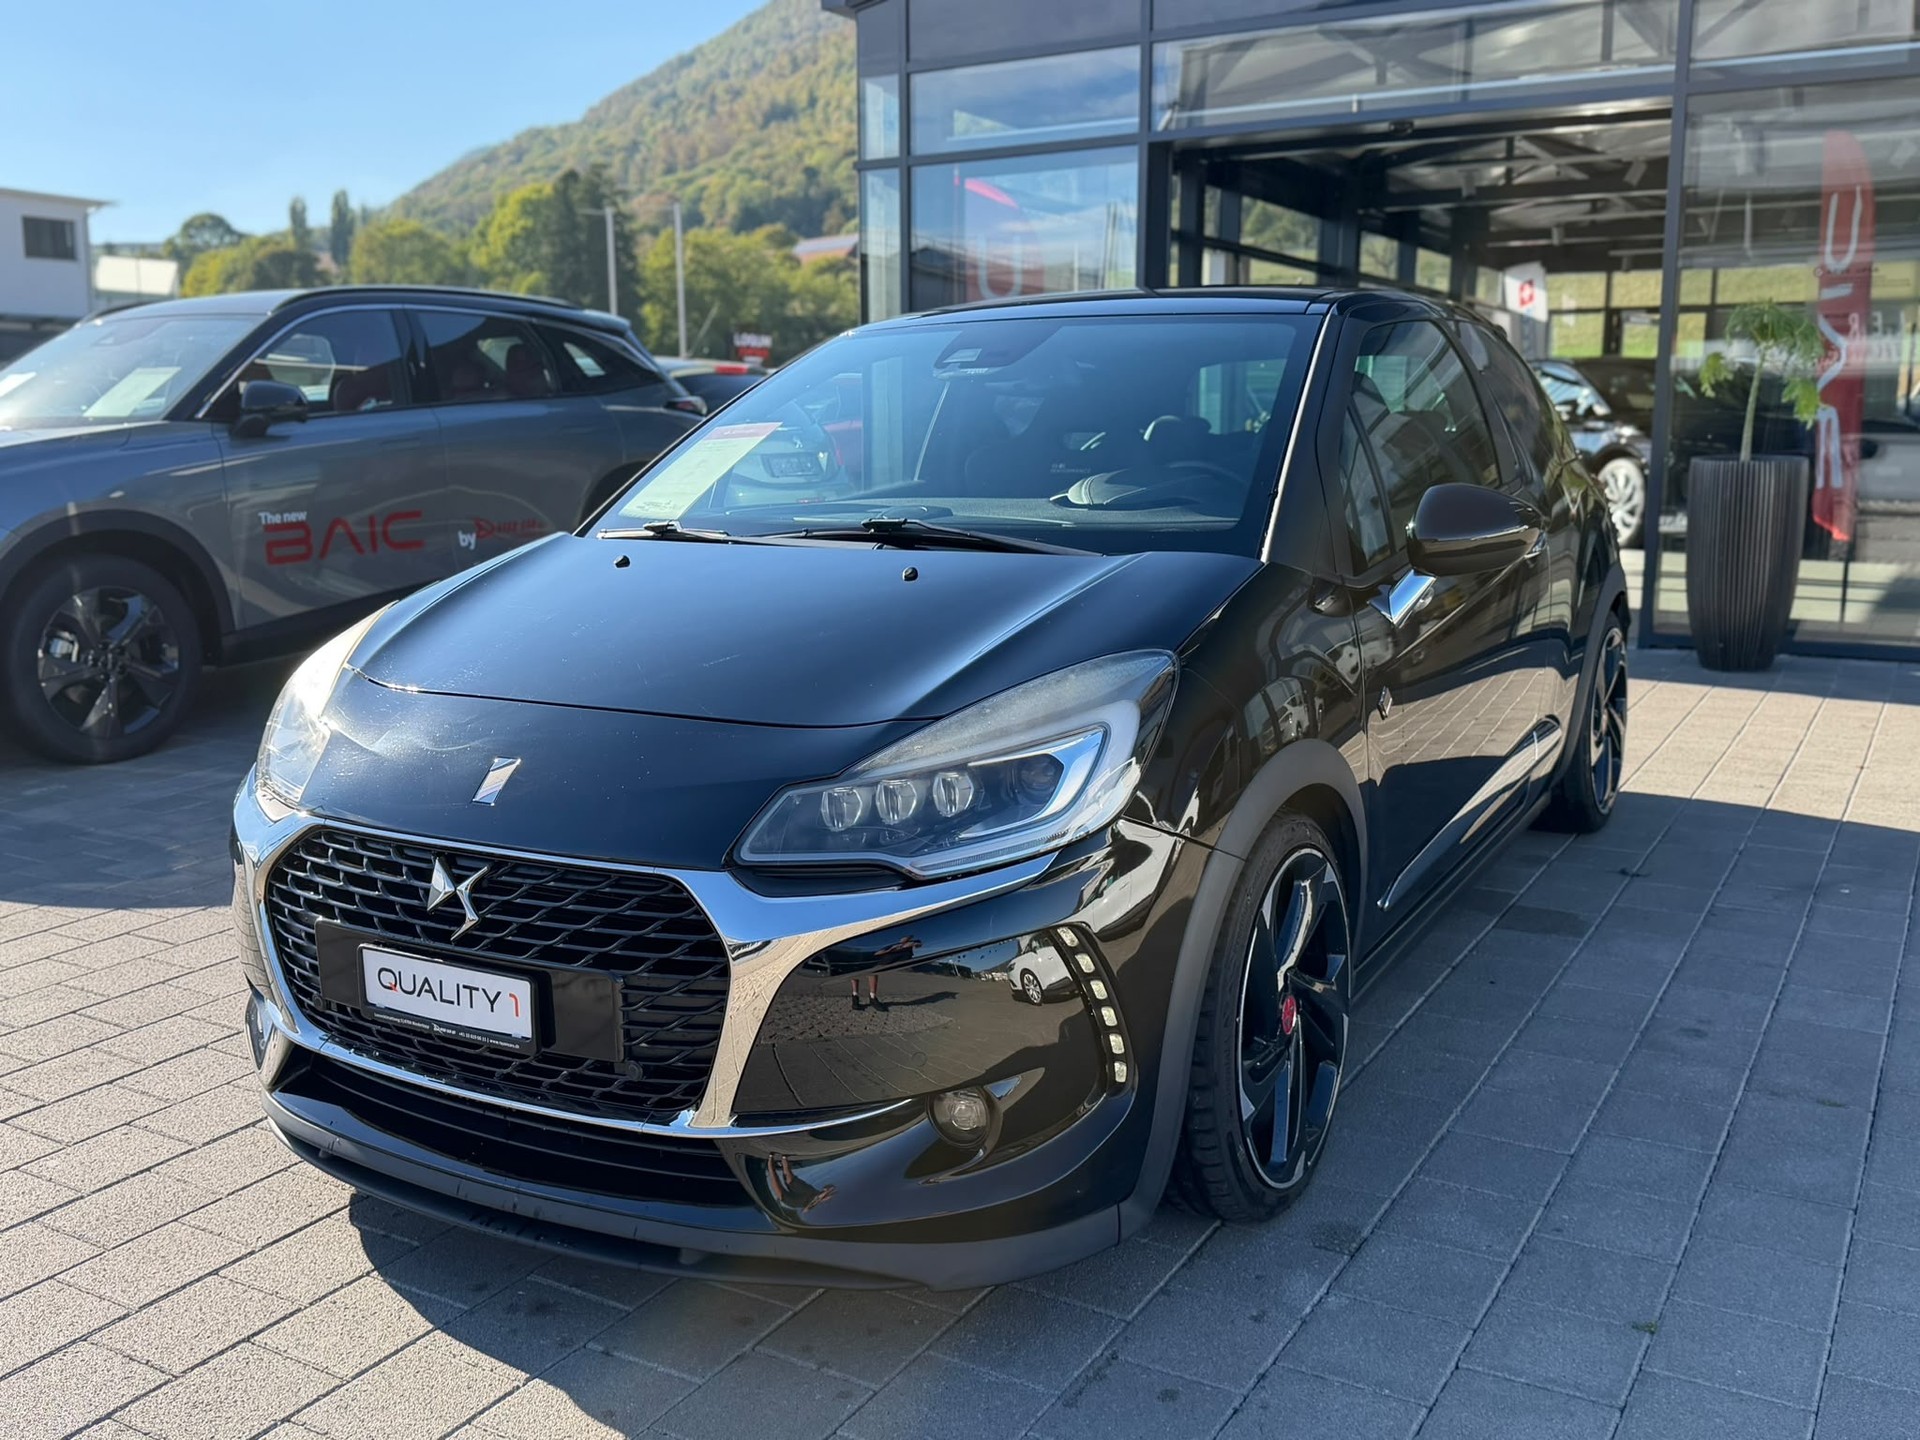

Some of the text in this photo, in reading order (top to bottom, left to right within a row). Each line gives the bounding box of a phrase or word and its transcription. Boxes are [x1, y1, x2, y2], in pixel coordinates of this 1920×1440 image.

[258, 509, 308, 525] The new
[264, 511, 424, 565] BAIC
[458, 530, 477, 550] by
[377, 967, 502, 1013] QUALITY
